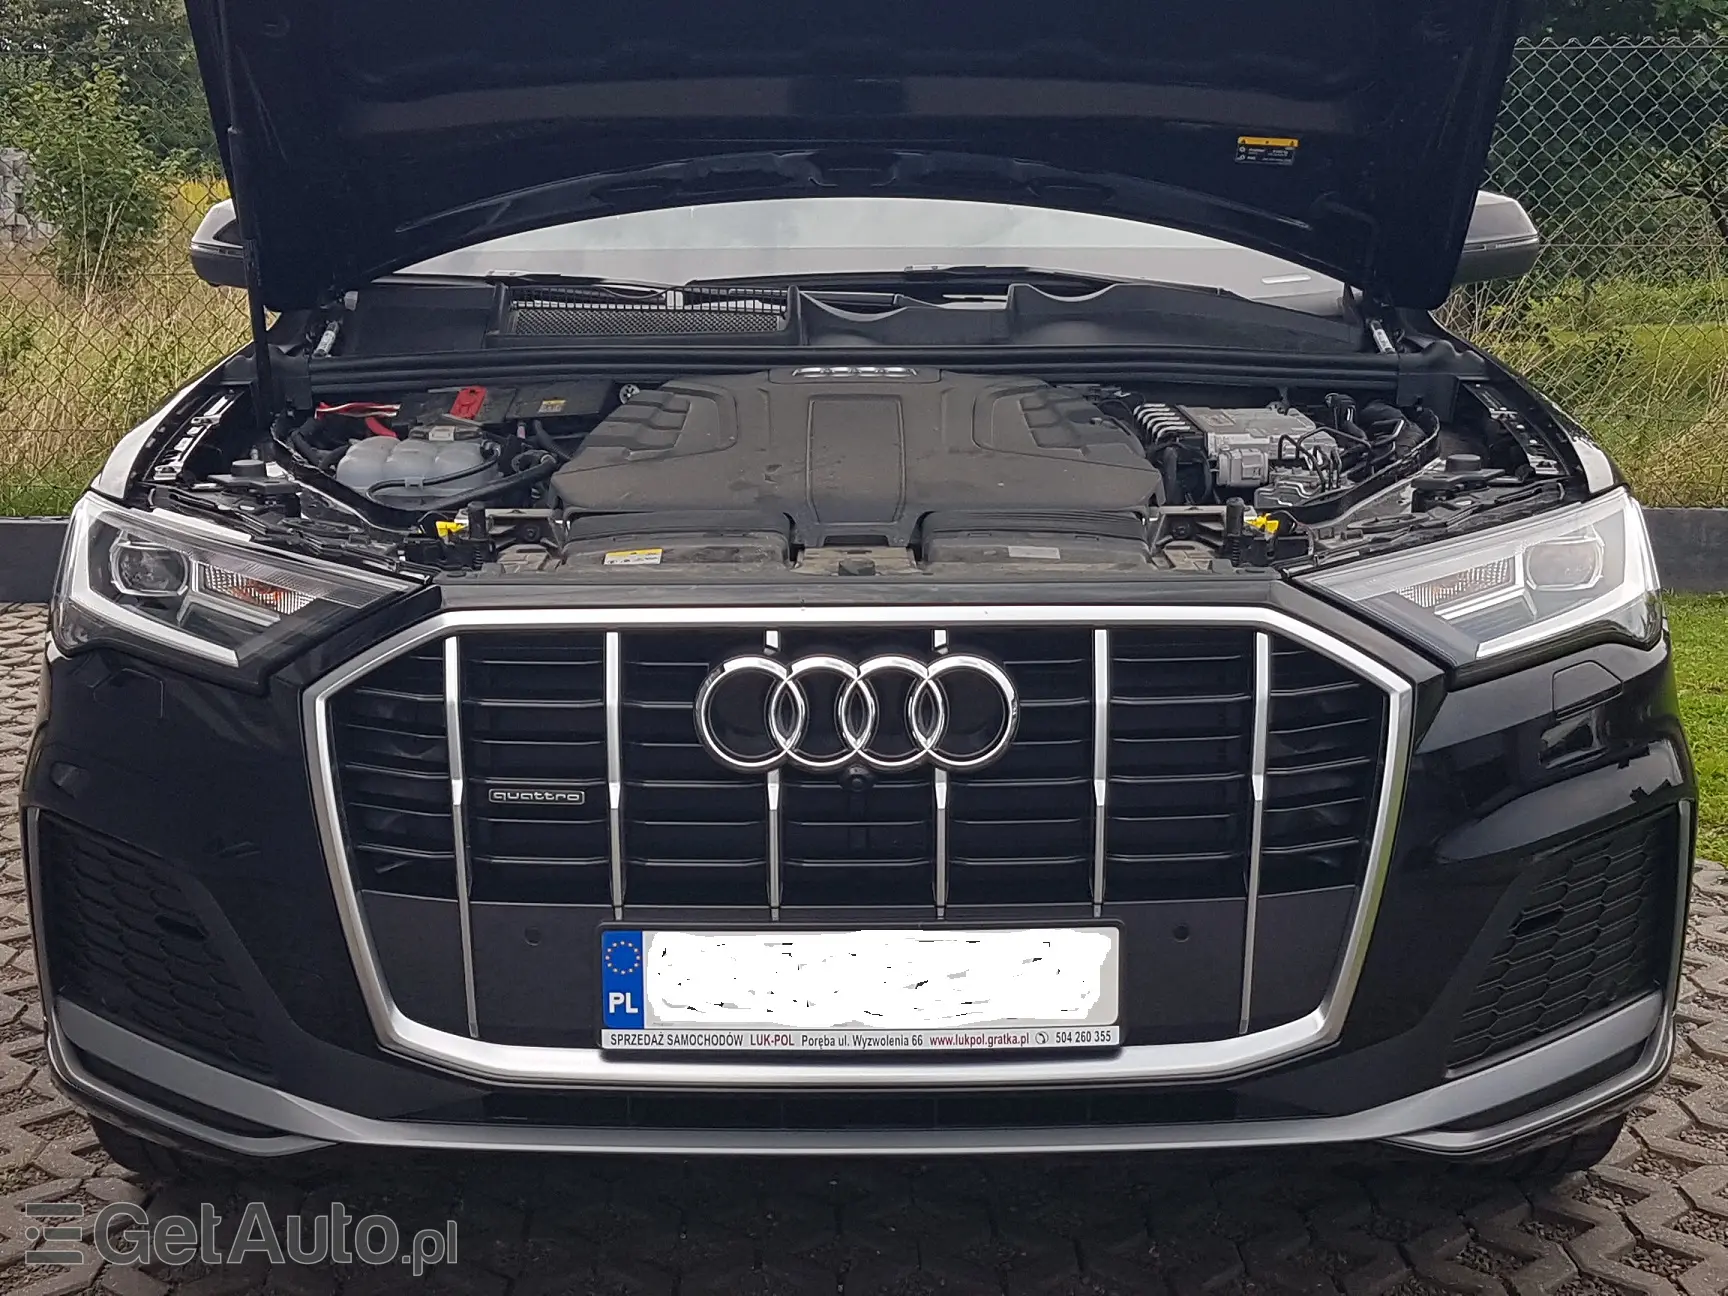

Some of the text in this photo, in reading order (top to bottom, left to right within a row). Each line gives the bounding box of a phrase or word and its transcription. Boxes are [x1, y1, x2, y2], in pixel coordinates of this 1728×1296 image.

[493, 791, 580, 802] quattro
[608, 992, 639, 1014] PL
[610, 1030, 1111, 1049] SPRZEDAŻ SAMOCHODÓW LUK-POL Poręba ul. Wyzwolenia 66 www.lukpol.gratka.pl 504 260 355
